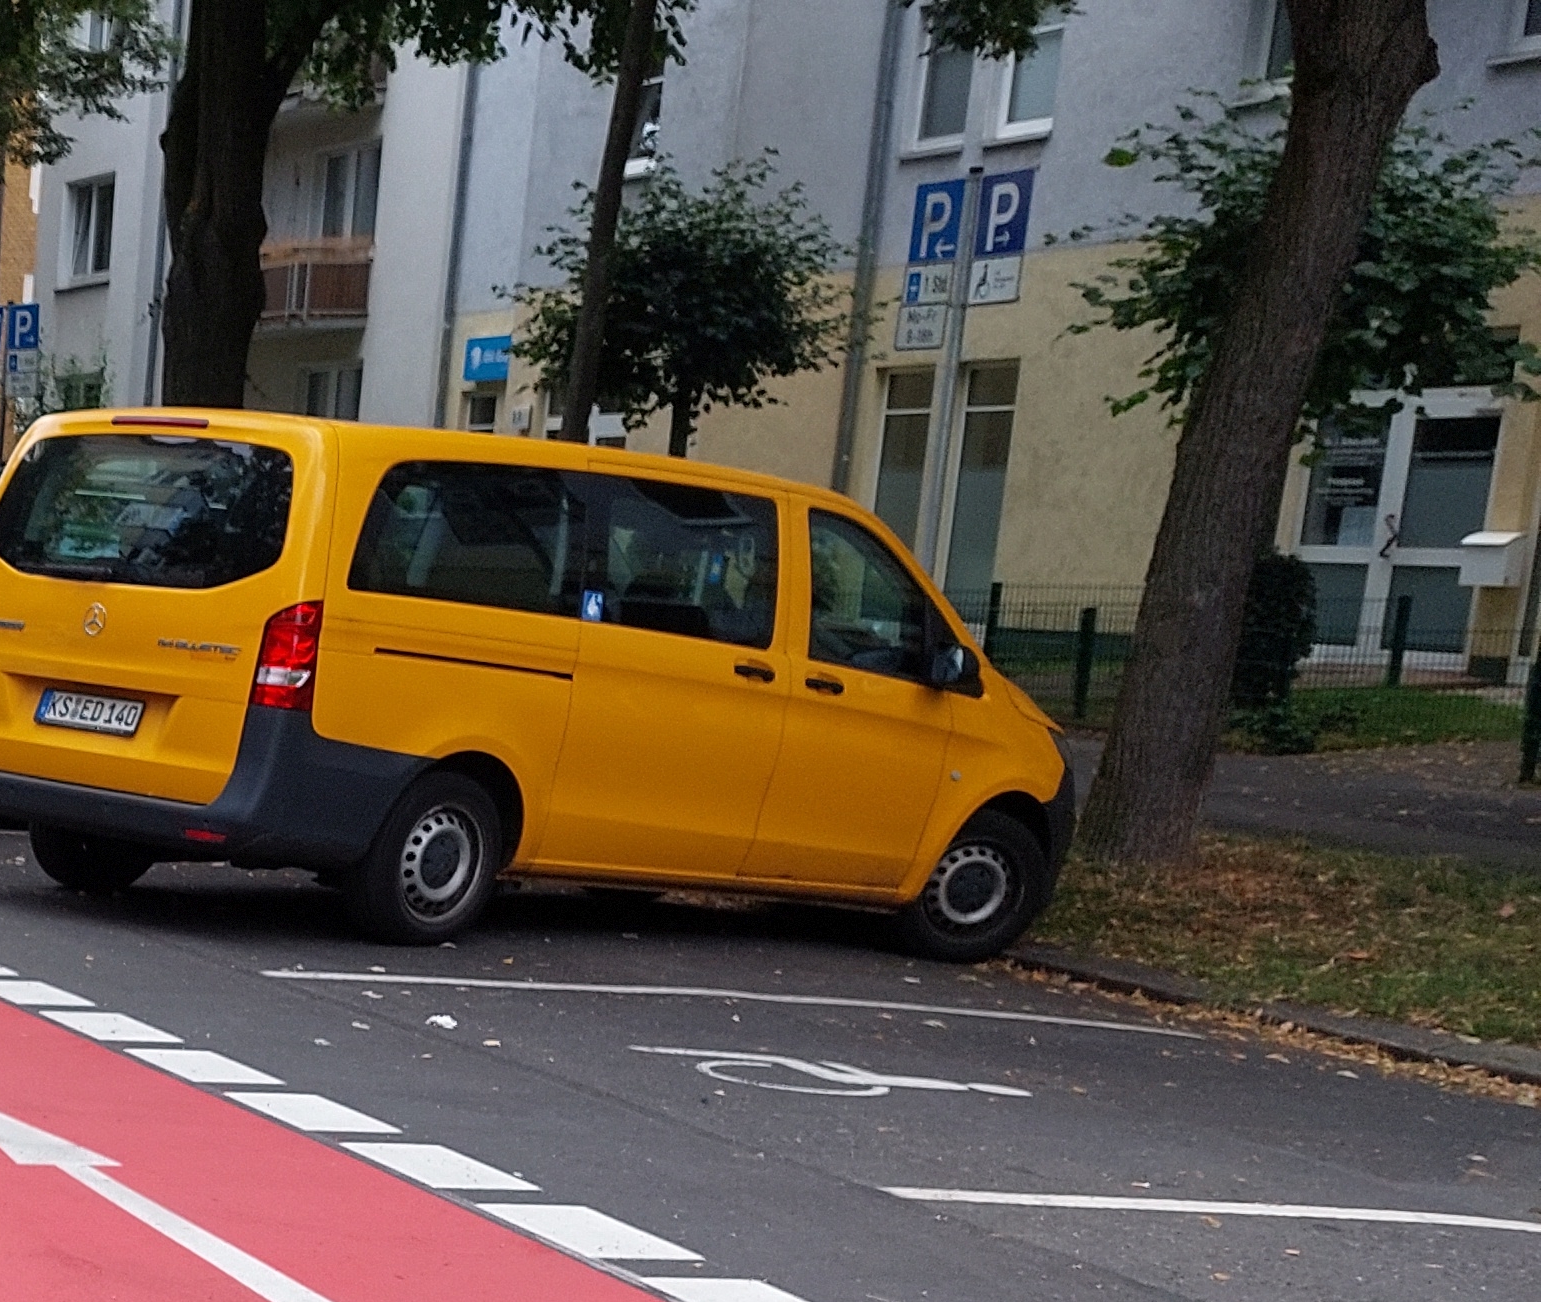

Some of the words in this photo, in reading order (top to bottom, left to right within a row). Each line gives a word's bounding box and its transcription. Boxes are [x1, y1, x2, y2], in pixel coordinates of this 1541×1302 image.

[919, 191, 952, 259] P
[985, 181, 1020, 253] P
[15, 310, 32, 346] P
[47, 693, 73, 718] KS
[78, 698, 105, 722] ED
[103, 702, 139, 727] 140
